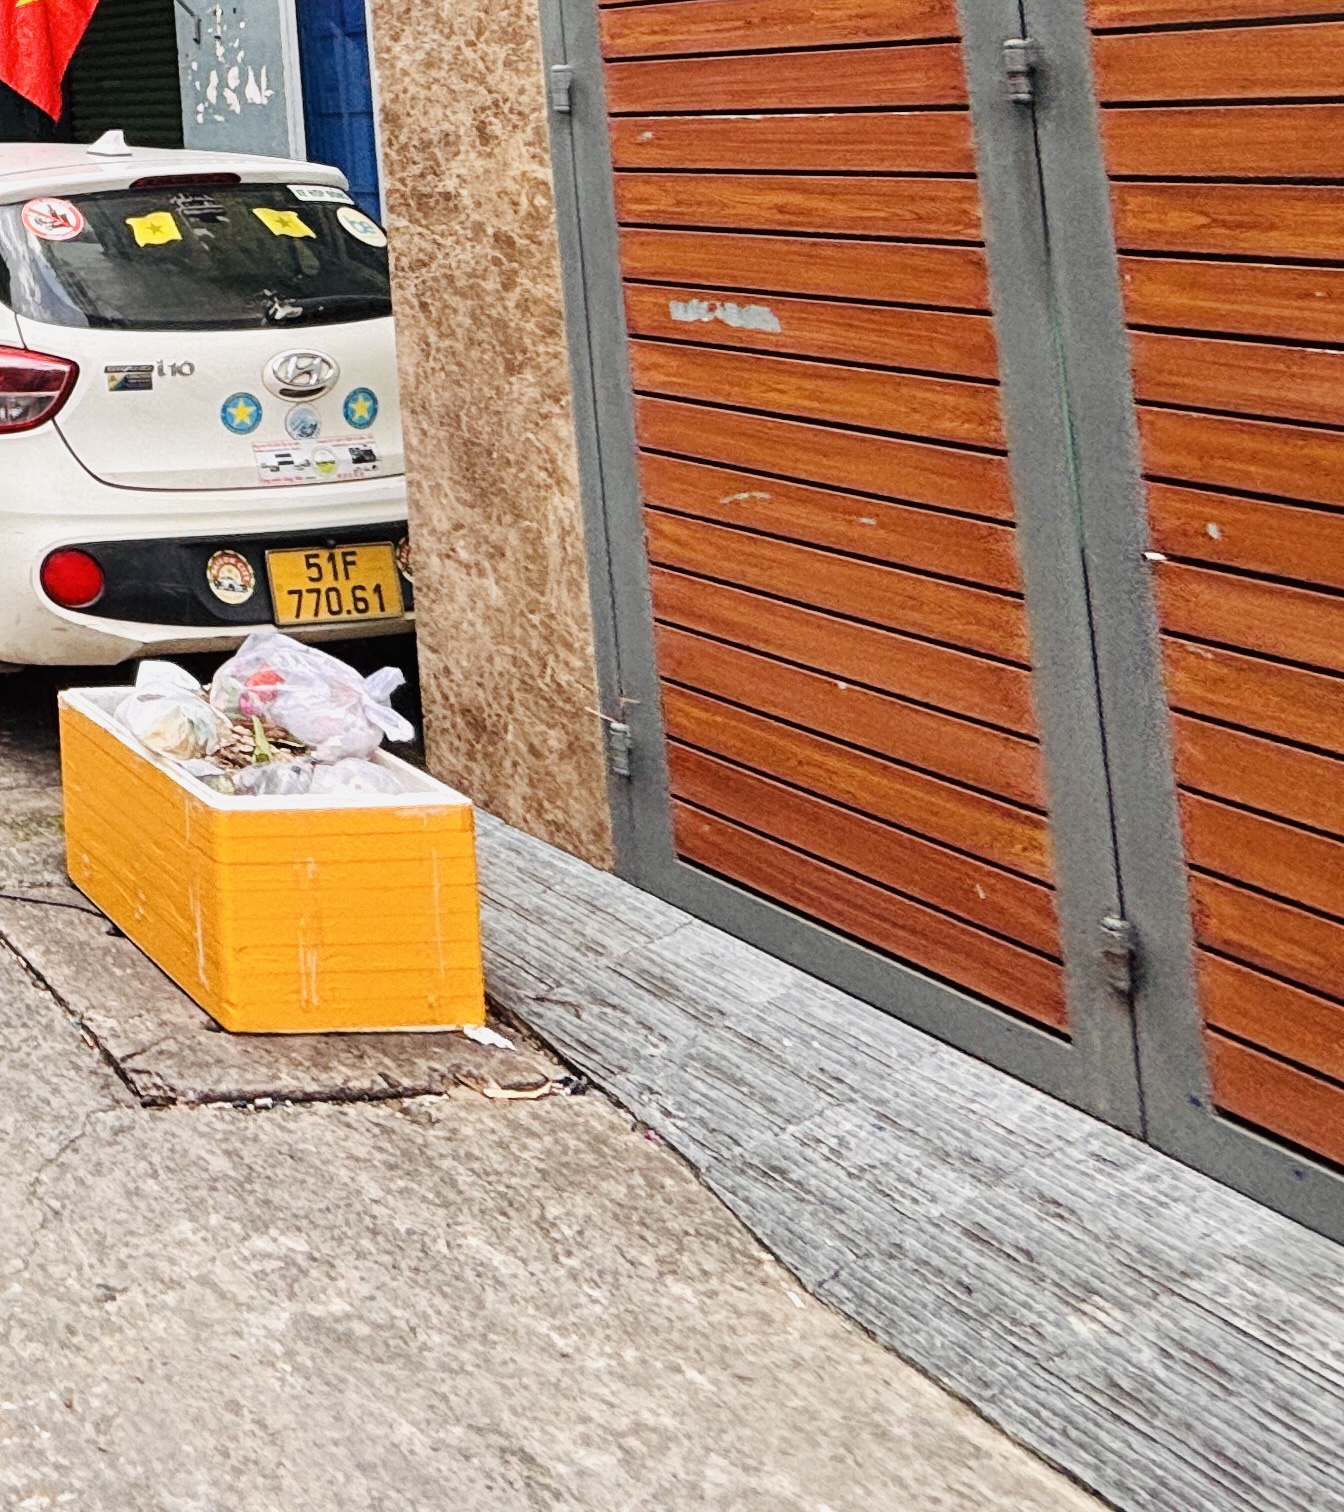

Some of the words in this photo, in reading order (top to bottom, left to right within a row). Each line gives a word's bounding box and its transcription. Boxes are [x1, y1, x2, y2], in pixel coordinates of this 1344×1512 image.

[157, 359, 196, 377] i10
[304, 551, 358, 583] 51F
[287, 583, 386, 620] 770.61
